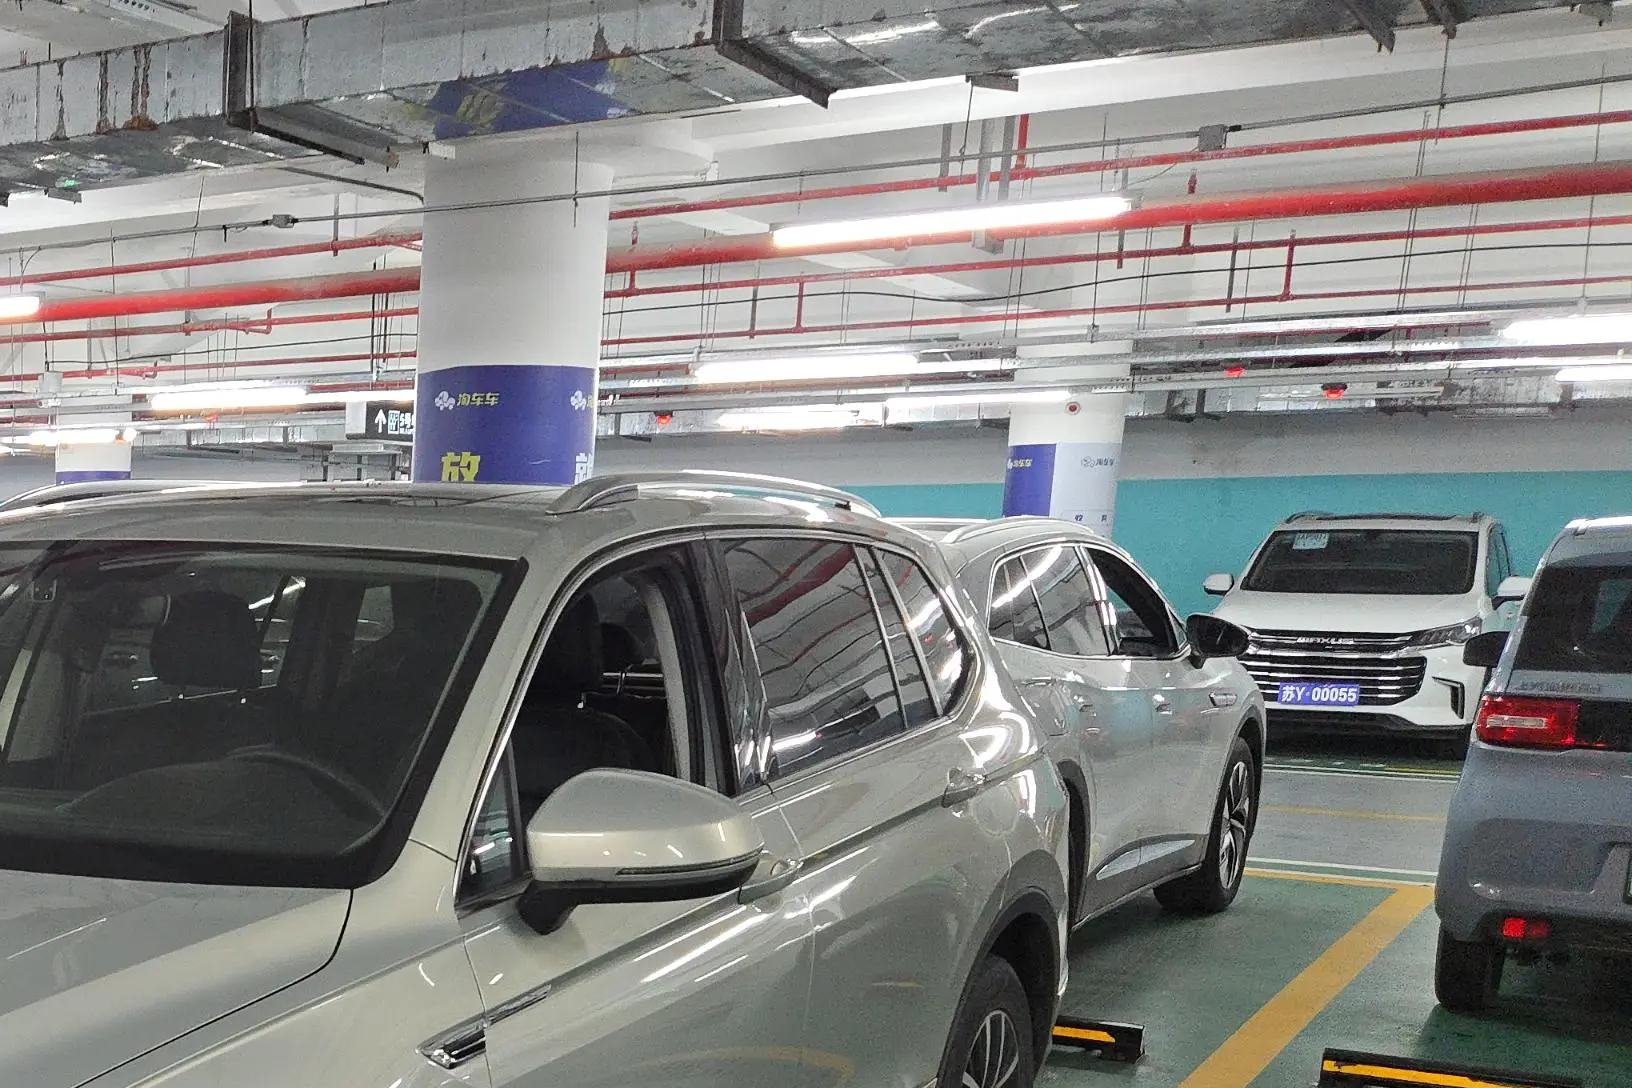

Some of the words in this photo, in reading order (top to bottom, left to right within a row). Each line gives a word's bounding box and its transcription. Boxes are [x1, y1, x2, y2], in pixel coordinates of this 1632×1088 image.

[457, 392, 500, 407] 淘车车
[441, 452, 481, 482] 放
